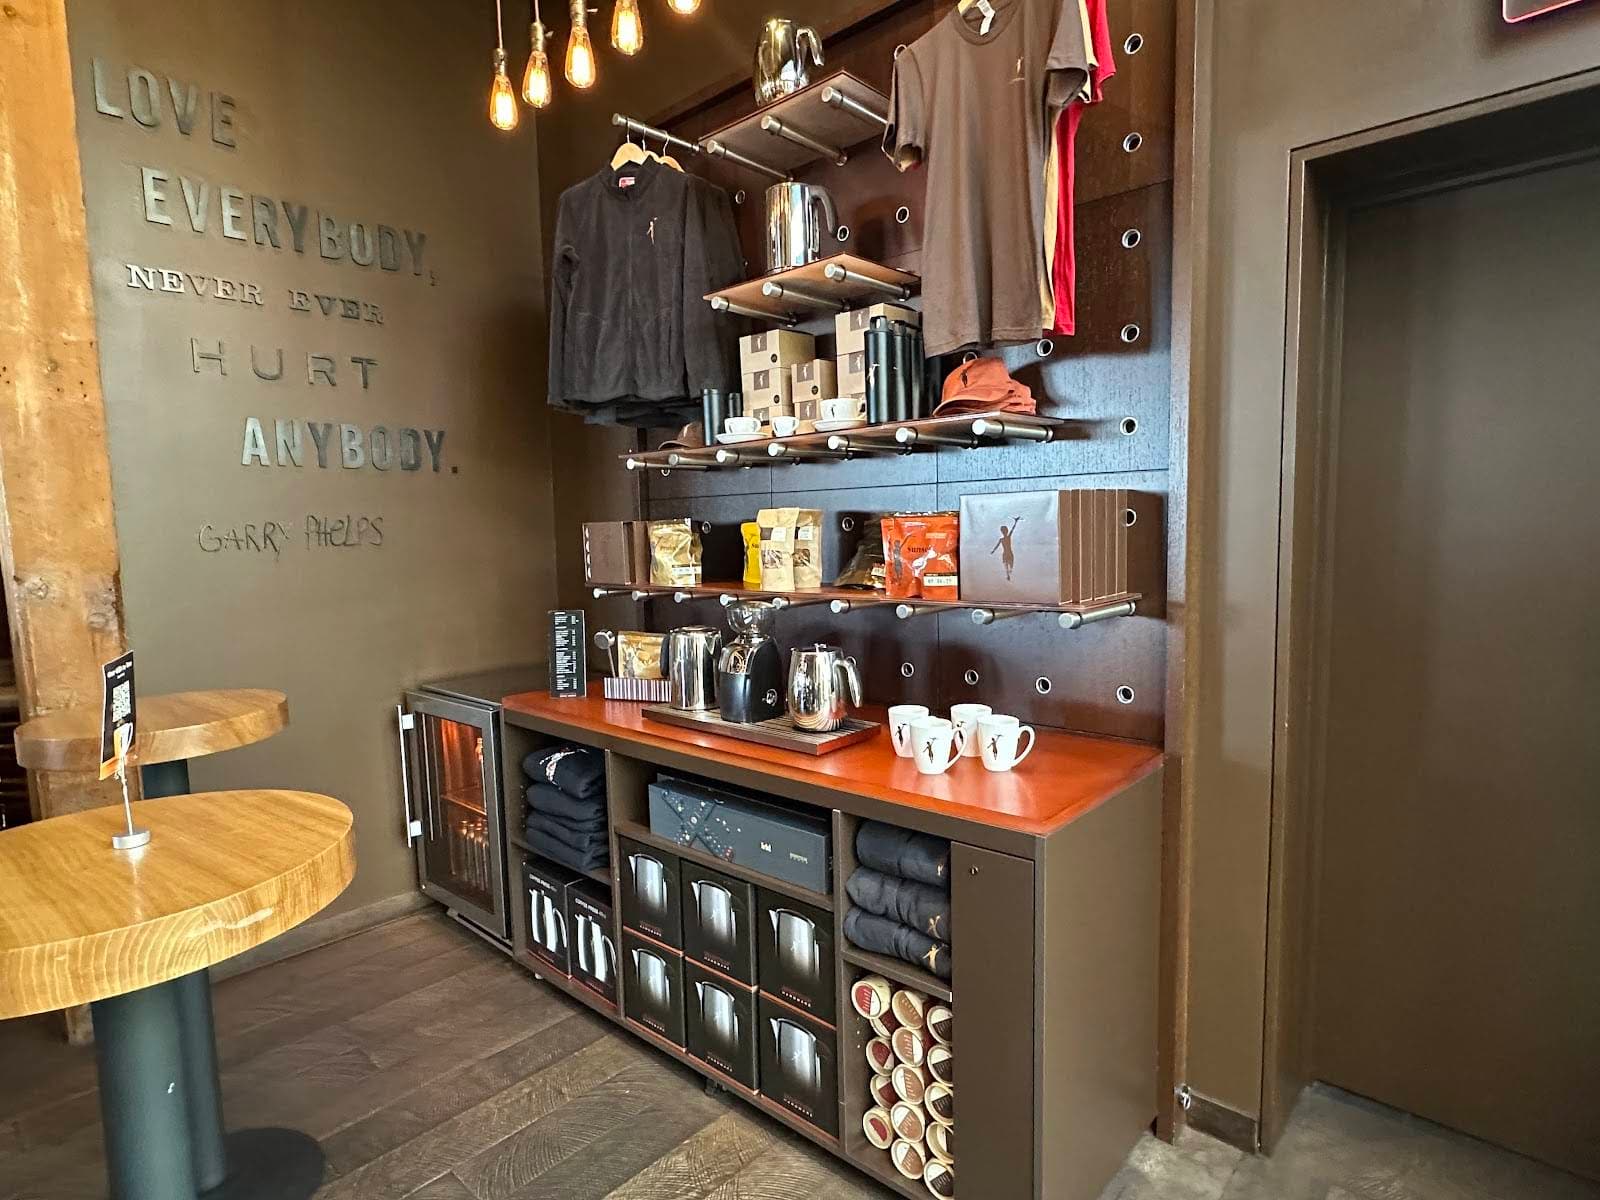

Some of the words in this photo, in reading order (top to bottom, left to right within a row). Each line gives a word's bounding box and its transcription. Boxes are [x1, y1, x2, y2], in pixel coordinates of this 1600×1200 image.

[91, 56, 236, 148] LOVE
[125, 263, 264, 306] NEVER
[288, 288, 385, 325] EVER
[189, 336, 379, 390] HURT
[240, 416, 459, 474] ANYBODY.
[198, 520, 290, 563] GARRY
